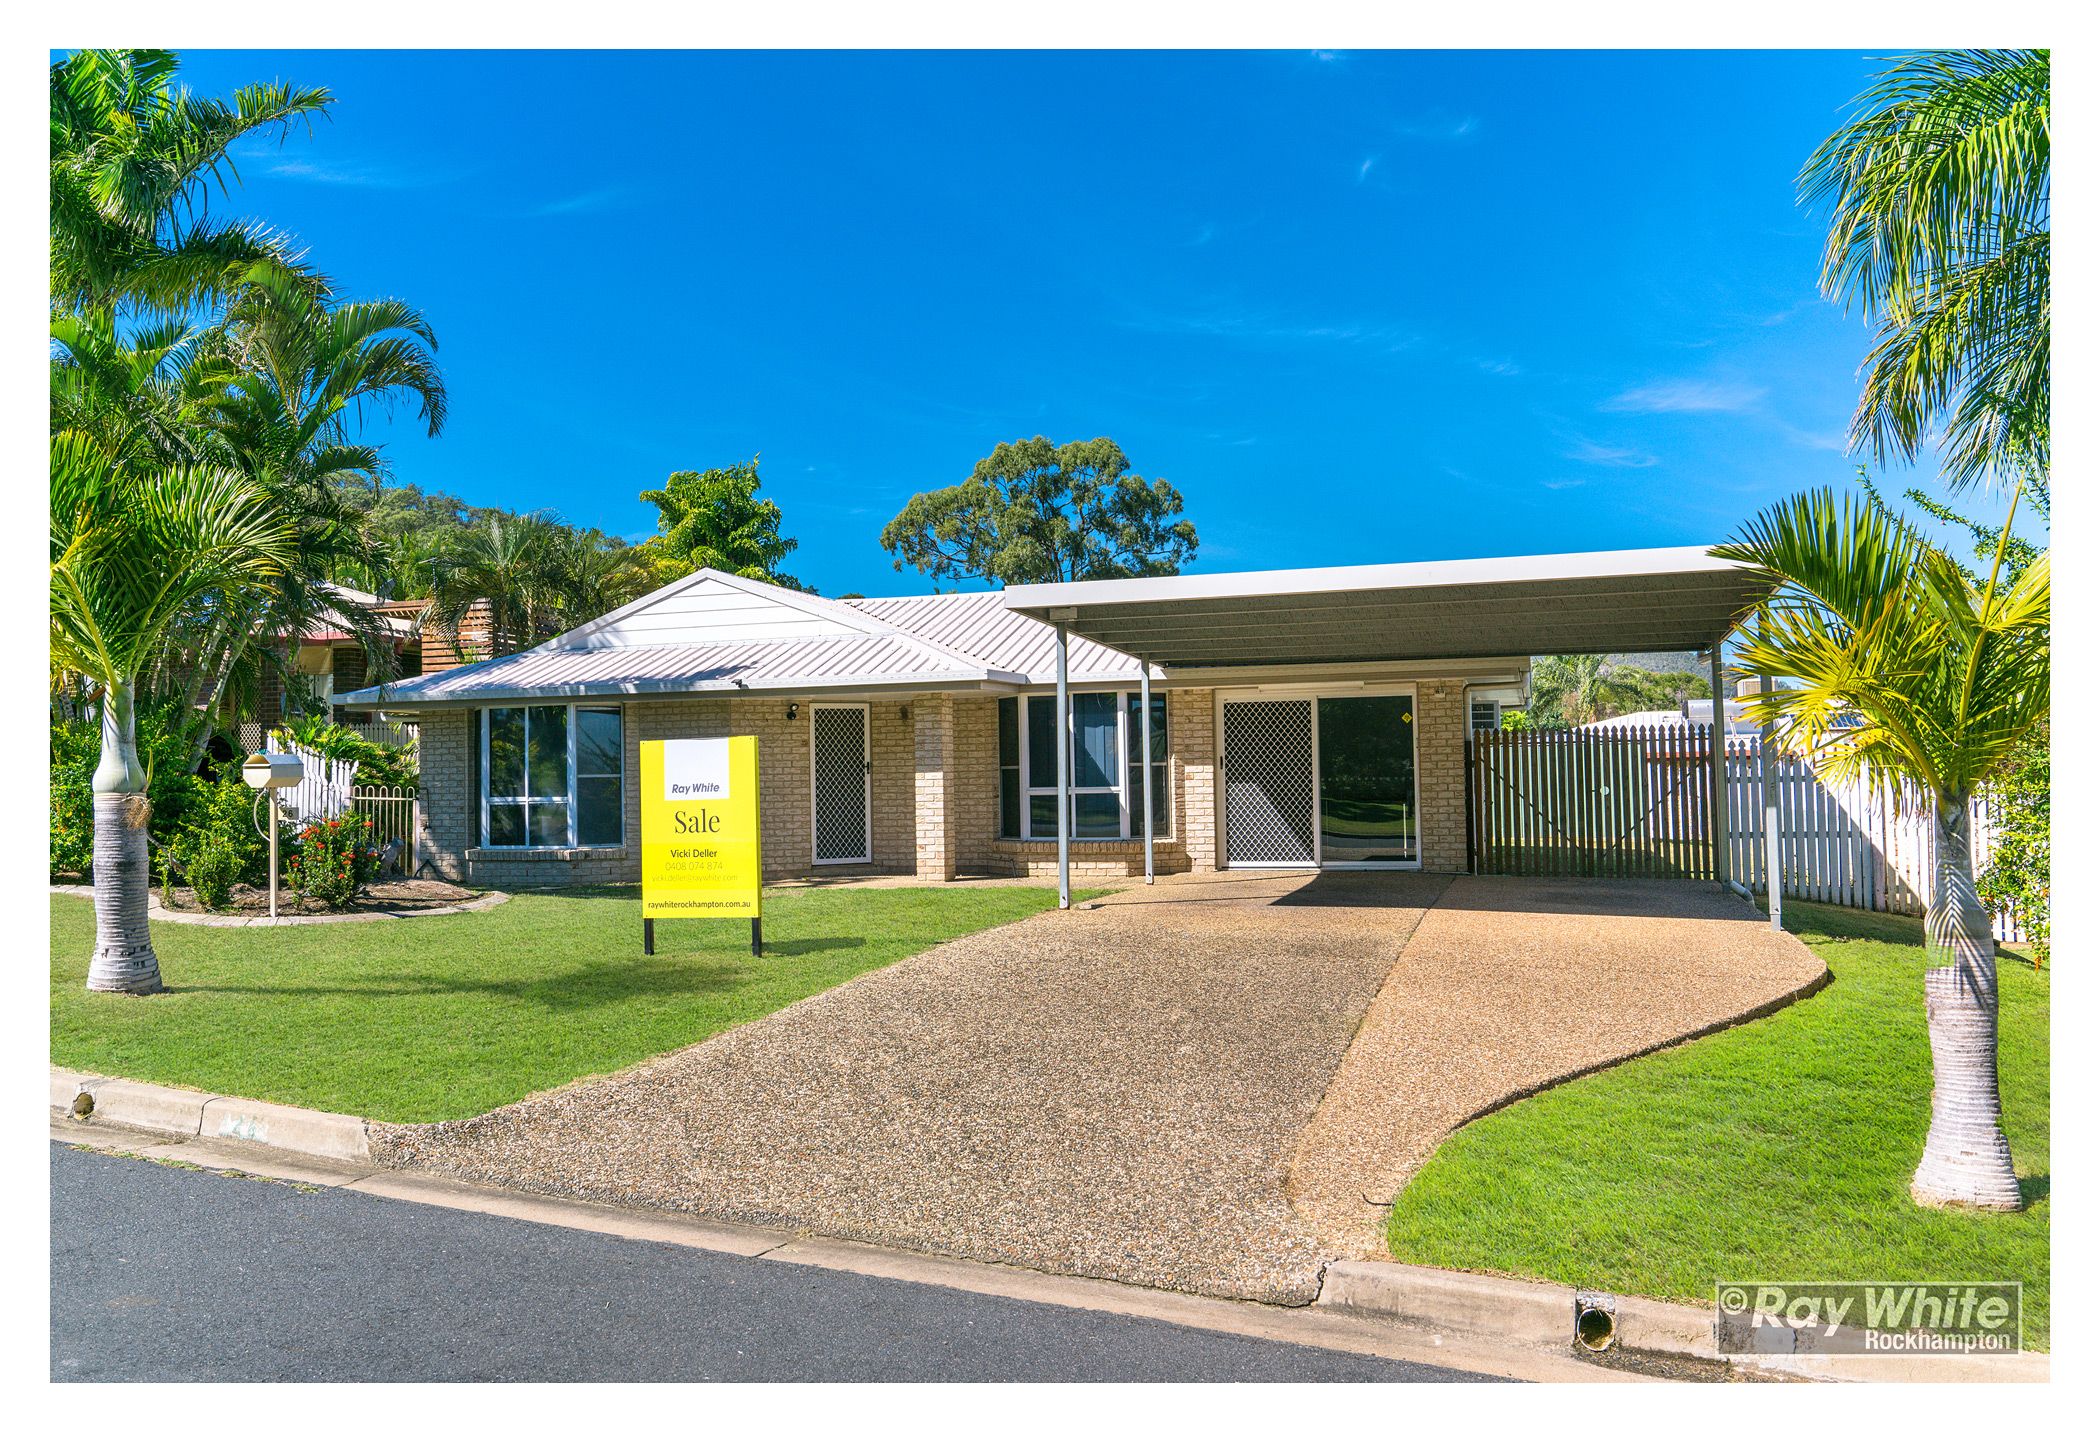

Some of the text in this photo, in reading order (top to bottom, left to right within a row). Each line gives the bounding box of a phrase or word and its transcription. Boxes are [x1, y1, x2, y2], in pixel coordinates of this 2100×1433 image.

[671, 783, 720, 795] Ray White
[674, 808, 721, 834] Sale
[670, 849, 718, 858] Vicki Deller
[665, 862, 723, 871] 0408 074 874
[647, 901, 751, 909] raywhiterockhampton.com.au
